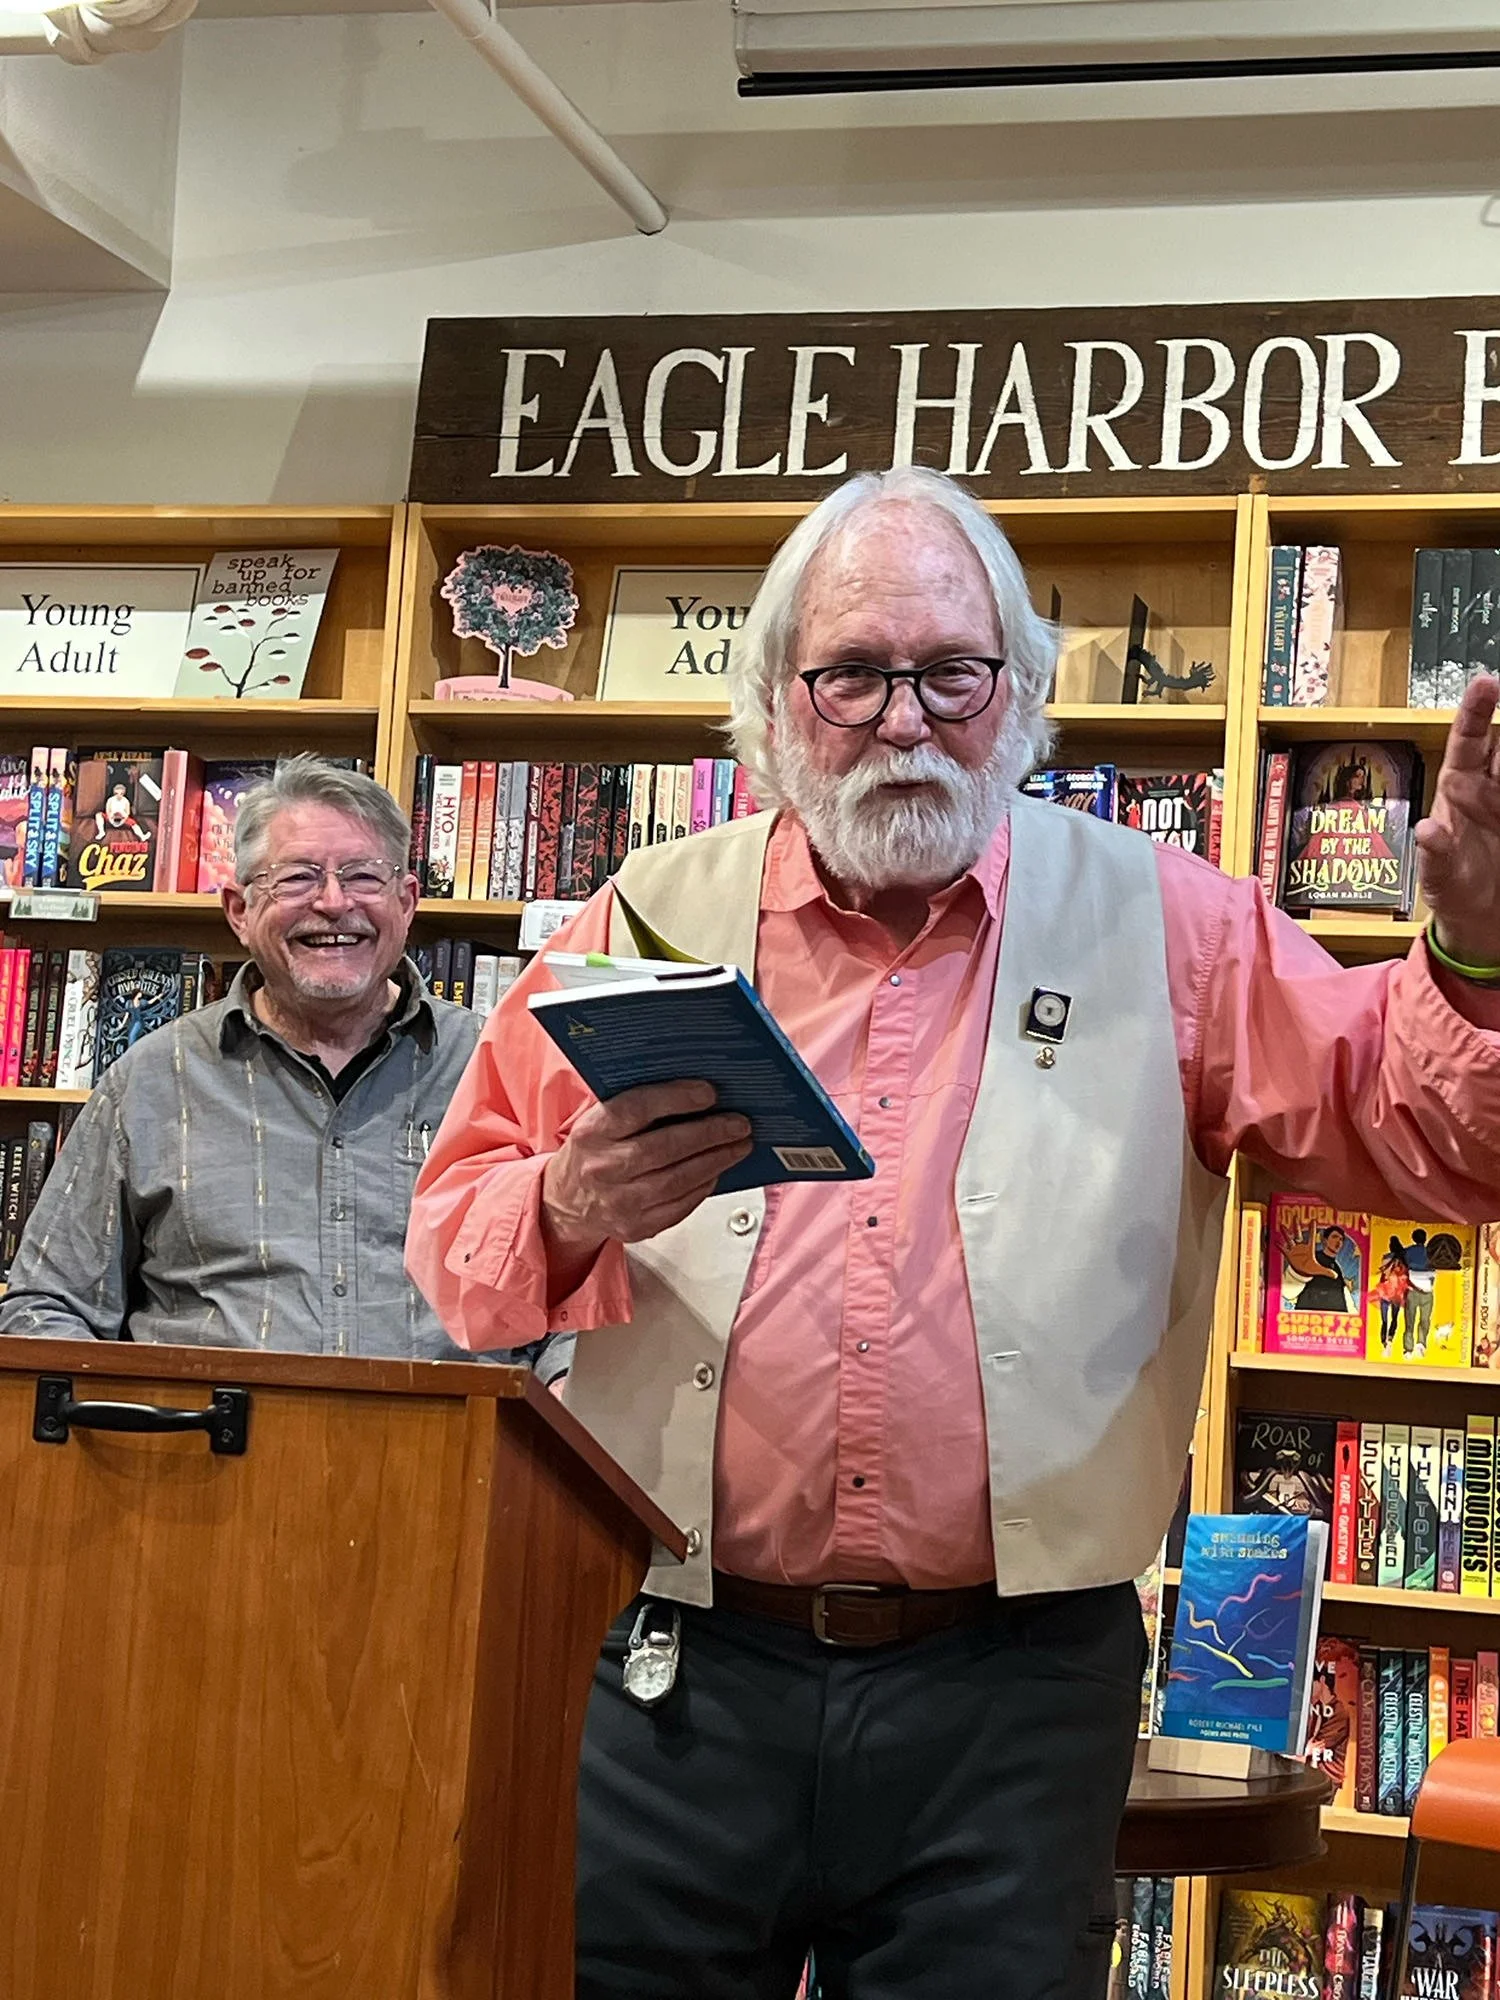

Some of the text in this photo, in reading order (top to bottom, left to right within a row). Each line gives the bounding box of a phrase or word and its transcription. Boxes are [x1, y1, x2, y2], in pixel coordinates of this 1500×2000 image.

[489, 346, 857, 478] EAGLE
[883, 332, 1405, 476] HARBOR
[227, 553, 296, 574] speak
[237, 565, 321, 584] up for
[212, 580, 292, 595] banned
[244, 592, 309, 607] books
[20, 594, 136, 636] Young
[665, 596, 751, 631] You
[1273, 605, 1287, 653] TWILIGHT
[16, 640, 121, 674] Adult
[27, 791, 43, 831] SPLIT
[46, 792, 61, 831] SPLIT
[442, 796, 457, 834] HYO
[1142, 797, 1184, 831] NOT
[1310, 808, 1387, 834] DREAM
[24, 840, 39, 868] SKY
[43, 842, 58, 870] SKY
[79, 843, 149, 881] Chaz
[1320, 837, 1372, 856] BY THE
[1289, 858, 1400, 886] SHADOWS
[8, 1146, 23, 1220] REBEL WITCH
[1277, 1312, 1363, 1328] GUIDE TO
[1278, 1323, 1362, 1338] BIPOLAR
[1250, 1422, 1312, 1450] ROAR
[1307, 1452, 1325, 1468] of
[1358, 1440, 1379, 1560] SCYTHE
[1412, 1443, 1432, 1570] THE TOLL
[1463, 1438, 1493, 1573] MINDWORKS
[1336, 1514, 1350, 1565] QUESTION
[1314, 1660, 1336, 1674] VE
[1310, 1705, 1334, 1718] ND
[1409, 1692, 1423, 1735] CELESTIAL
[1455, 1677, 1470, 1738] THE HAT
[1359, 1679, 1376, 1794] CEMETERY BOYS
[1382, 1691, 1398, 1784] CELESTIAL MONSTERS
[1222, 1964, 1320, 2000] SLEEPLESS
[1411, 1966, 1460, 2000] WAR
